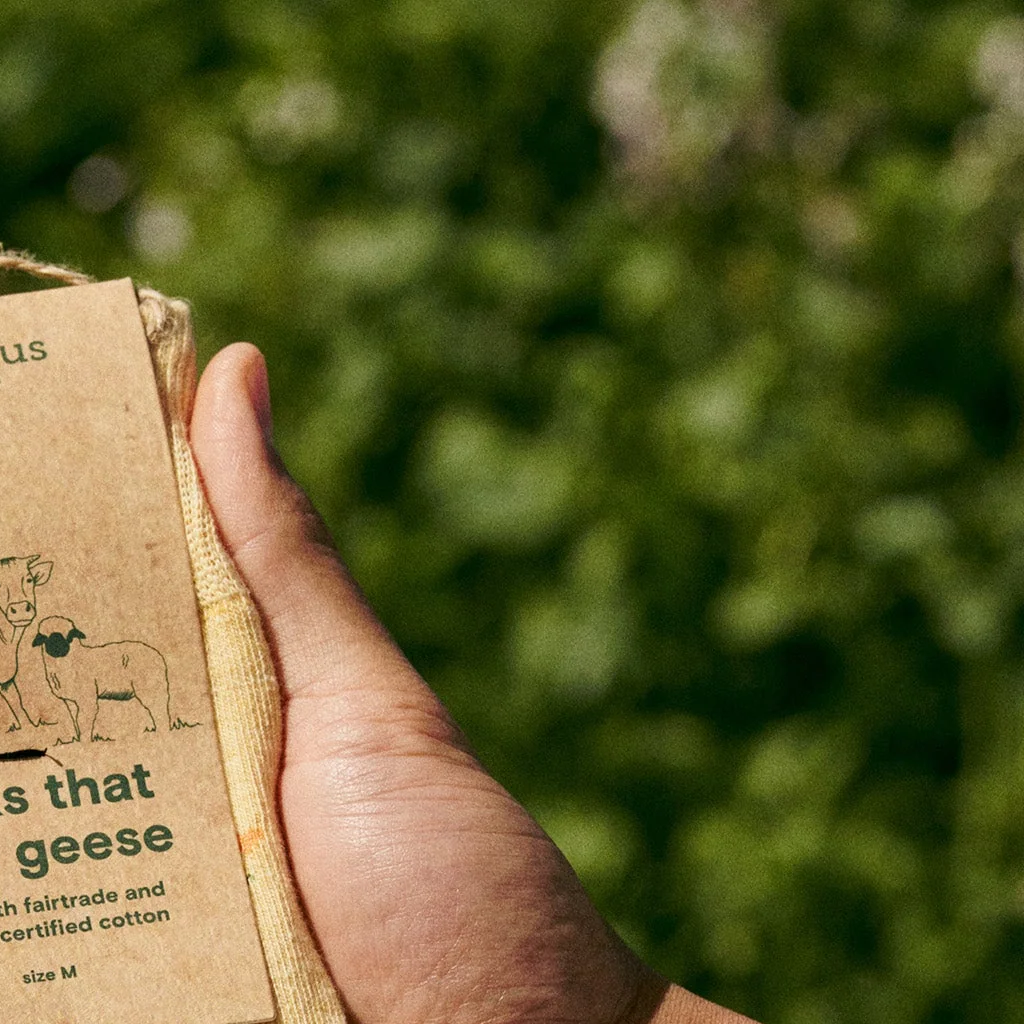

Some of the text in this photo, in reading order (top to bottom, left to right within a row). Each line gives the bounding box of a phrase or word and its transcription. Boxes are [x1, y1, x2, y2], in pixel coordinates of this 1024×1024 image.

[44, 764, 155, 809] that
[15, 824, 174, 879] geese
[23, 888, 119, 915] fairtrade
[125, 881, 166, 900] and
[0, 916, 93, 942] certified
[99, 908, 171, 930] cotton
[22, 965, 77, 984] size M
